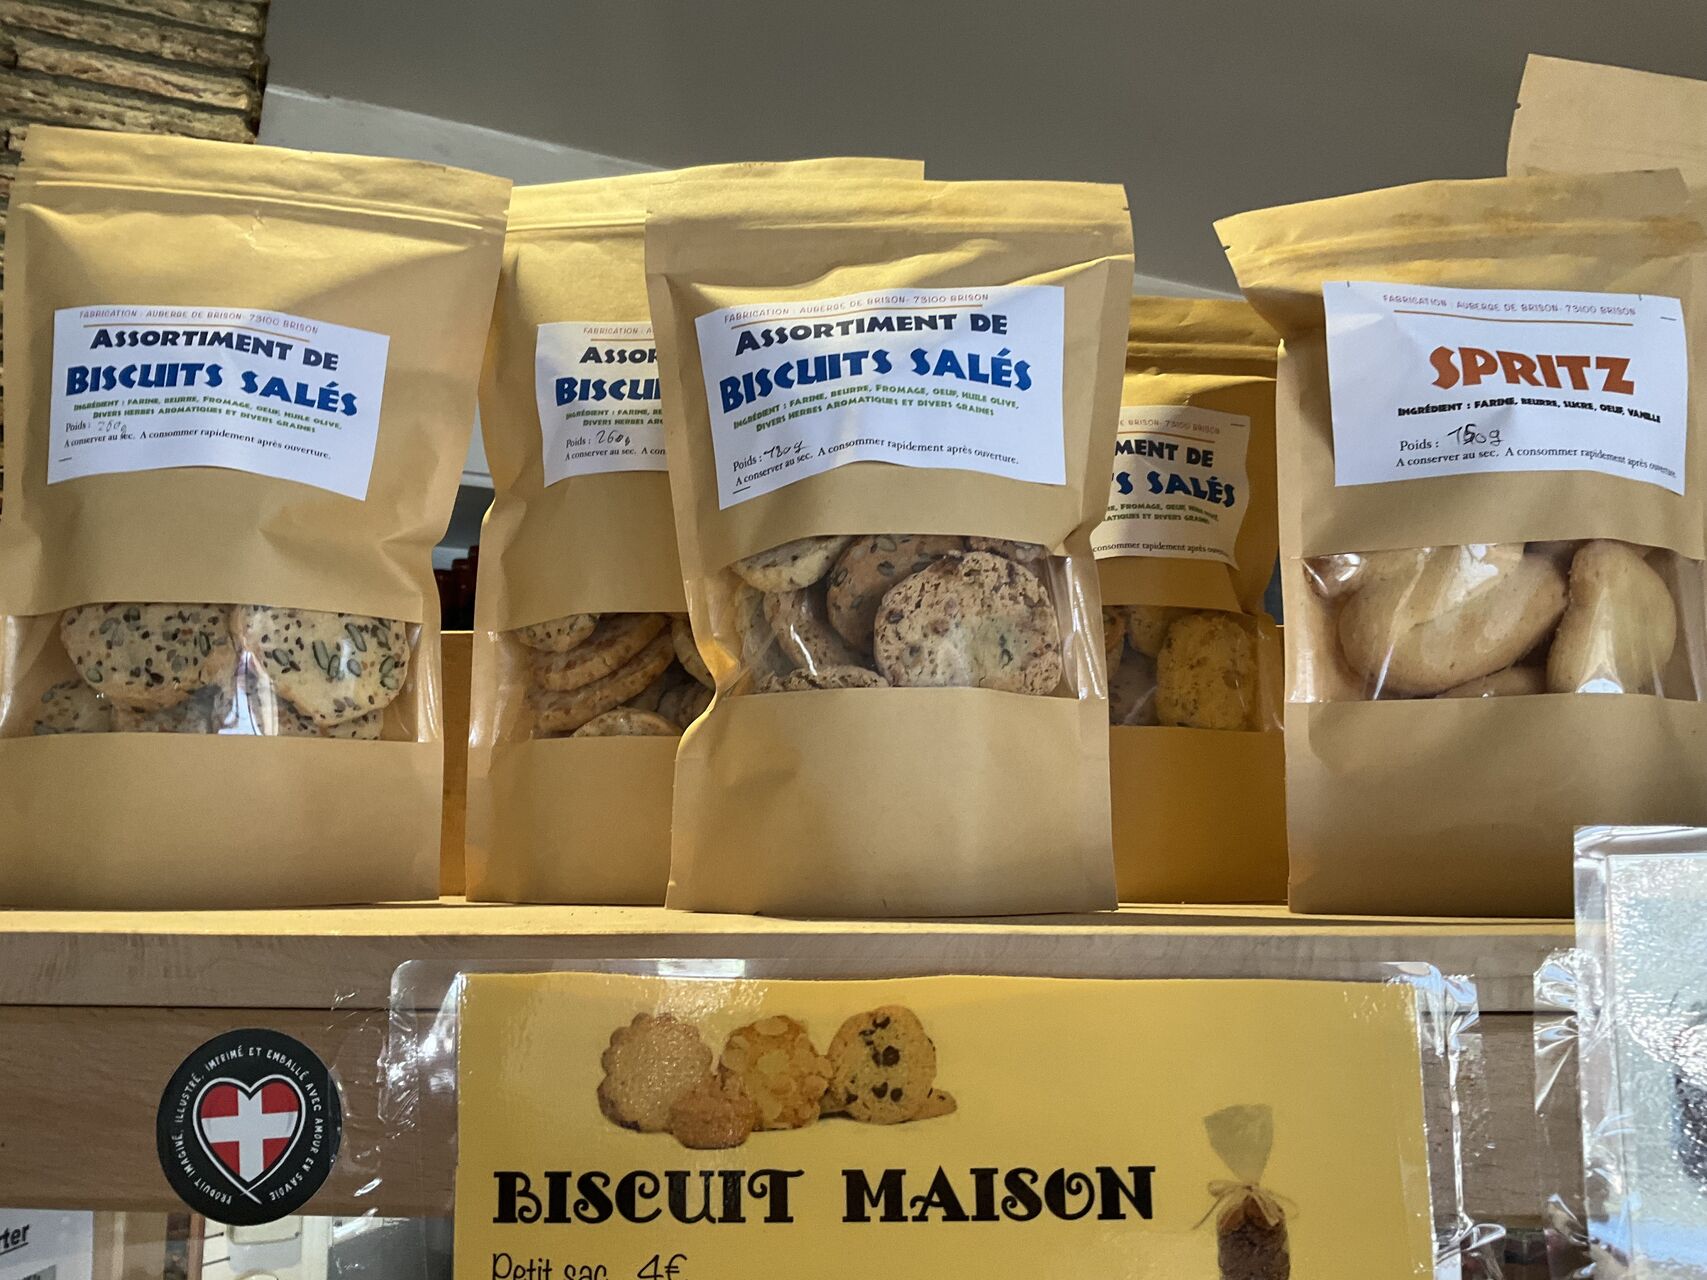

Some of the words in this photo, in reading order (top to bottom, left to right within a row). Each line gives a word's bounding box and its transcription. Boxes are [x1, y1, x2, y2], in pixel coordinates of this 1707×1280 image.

[724, 308, 790, 324] FABRICATION
[913, 296, 947, 304] 73100
[950, 293, 989, 302] BRISON
[1382, 294, 1447, 306] FABRICATION
[1504, 303, 1517, 312] DE
[1565, 304, 1597, 313] 73100
[1600, 306, 1636, 315] BRISON
[79, 310, 137, 319] FABRICATION
[250, 314, 279, 326] 73100
[282, 321, 319, 334] BRISON
[735, 313, 958, 356] ASSORTIMENT
[970, 313, 1008, 335] DE
[89, 329, 293, 360] ASSORTIMENT
[302, 347, 339, 371] DE
[719, 348, 893, 414] BISCUITS
[910, 347, 1032, 391] SALÉS
[1429, 345, 1635, 395] SPRITZ
[65, 363, 223, 396] BISCUITS
[240, 370, 357, 416] SALÉS
[789, 392, 828, 407] FARINE,
[875, 384, 929, 396] FROMAGE,
[990, 396, 1019, 409] OLIVE,
[92, 408, 121, 419] DIVERS
[240, 412, 273, 424] DIVERS
[756, 415, 786, 432] DIVERS
[788, 405, 823, 420] HERBES
[826, 395, 898, 411] AROMATIQUES
[917, 399, 952, 408] DIVERS
[955, 402, 994, 416] GRAINES
[1398, 402, 1463, 416] INGRÉDIENT
[71, 434, 105, 446] conserver
[108, 433, 118, 441] au
[148, 429, 198, 439] consommer
[200, 428, 255, 443] rapidement
[257, 438, 282, 449] après
[284, 443, 332, 459] ouverture.
[571, 449, 608, 459] conserver
[1186, 446, 1214, 468] DE
[1396, 458, 1405, 467] A
[1407, 453, 1460, 466] conserver
[1462, 452, 1475, 460] au
[1478, 450, 1499, 458] sec.
[1505, 447, 1514, 457] A
[1517, 448, 1578, 457] consommer
[1580, 448, 1626, 464] rapidement
[1627, 458, 1648, 469] après
[743, 464, 783, 483] conserver
[785, 458, 795, 468] au
[796, 453, 814, 466] sec.
[817, 447, 826, 457] A
[827, 438, 885, 454] consommer
[887, 440, 944, 452] rapidement
[946, 444, 972, 455] après
[974, 449, 1019, 464] ouverture.
[1111, 471, 1134, 495] S
[1146, 470, 1236, 508] SALÉS
[1104, 513, 1140, 521] ATIQUES
[1092, 542, 1140, 553] consommer
[1142, 541, 1186, 552] rapidement
[204, 1045, 243, 1071] IMPRIMÉ
[248, 1047, 262, 1056] ET
[266, 1049, 309, 1080] EMBALLÉ
[174, 1072, 204, 1123] ILLUSTRÉ,
[305, 1082, 322, 1111] AVEC
[310, 1118, 324, 1154] AMOUR
[301, 1157, 314, 1172] EN
[194, 1178, 232, 1205] PRODUIT
[269, 1172, 303, 1201] SAVOIE
[492, 1169, 805, 1223] BISCUIT
[840, 1165, 1156, 1223] MAISON
[493, 1252, 552, 1280] Petit
